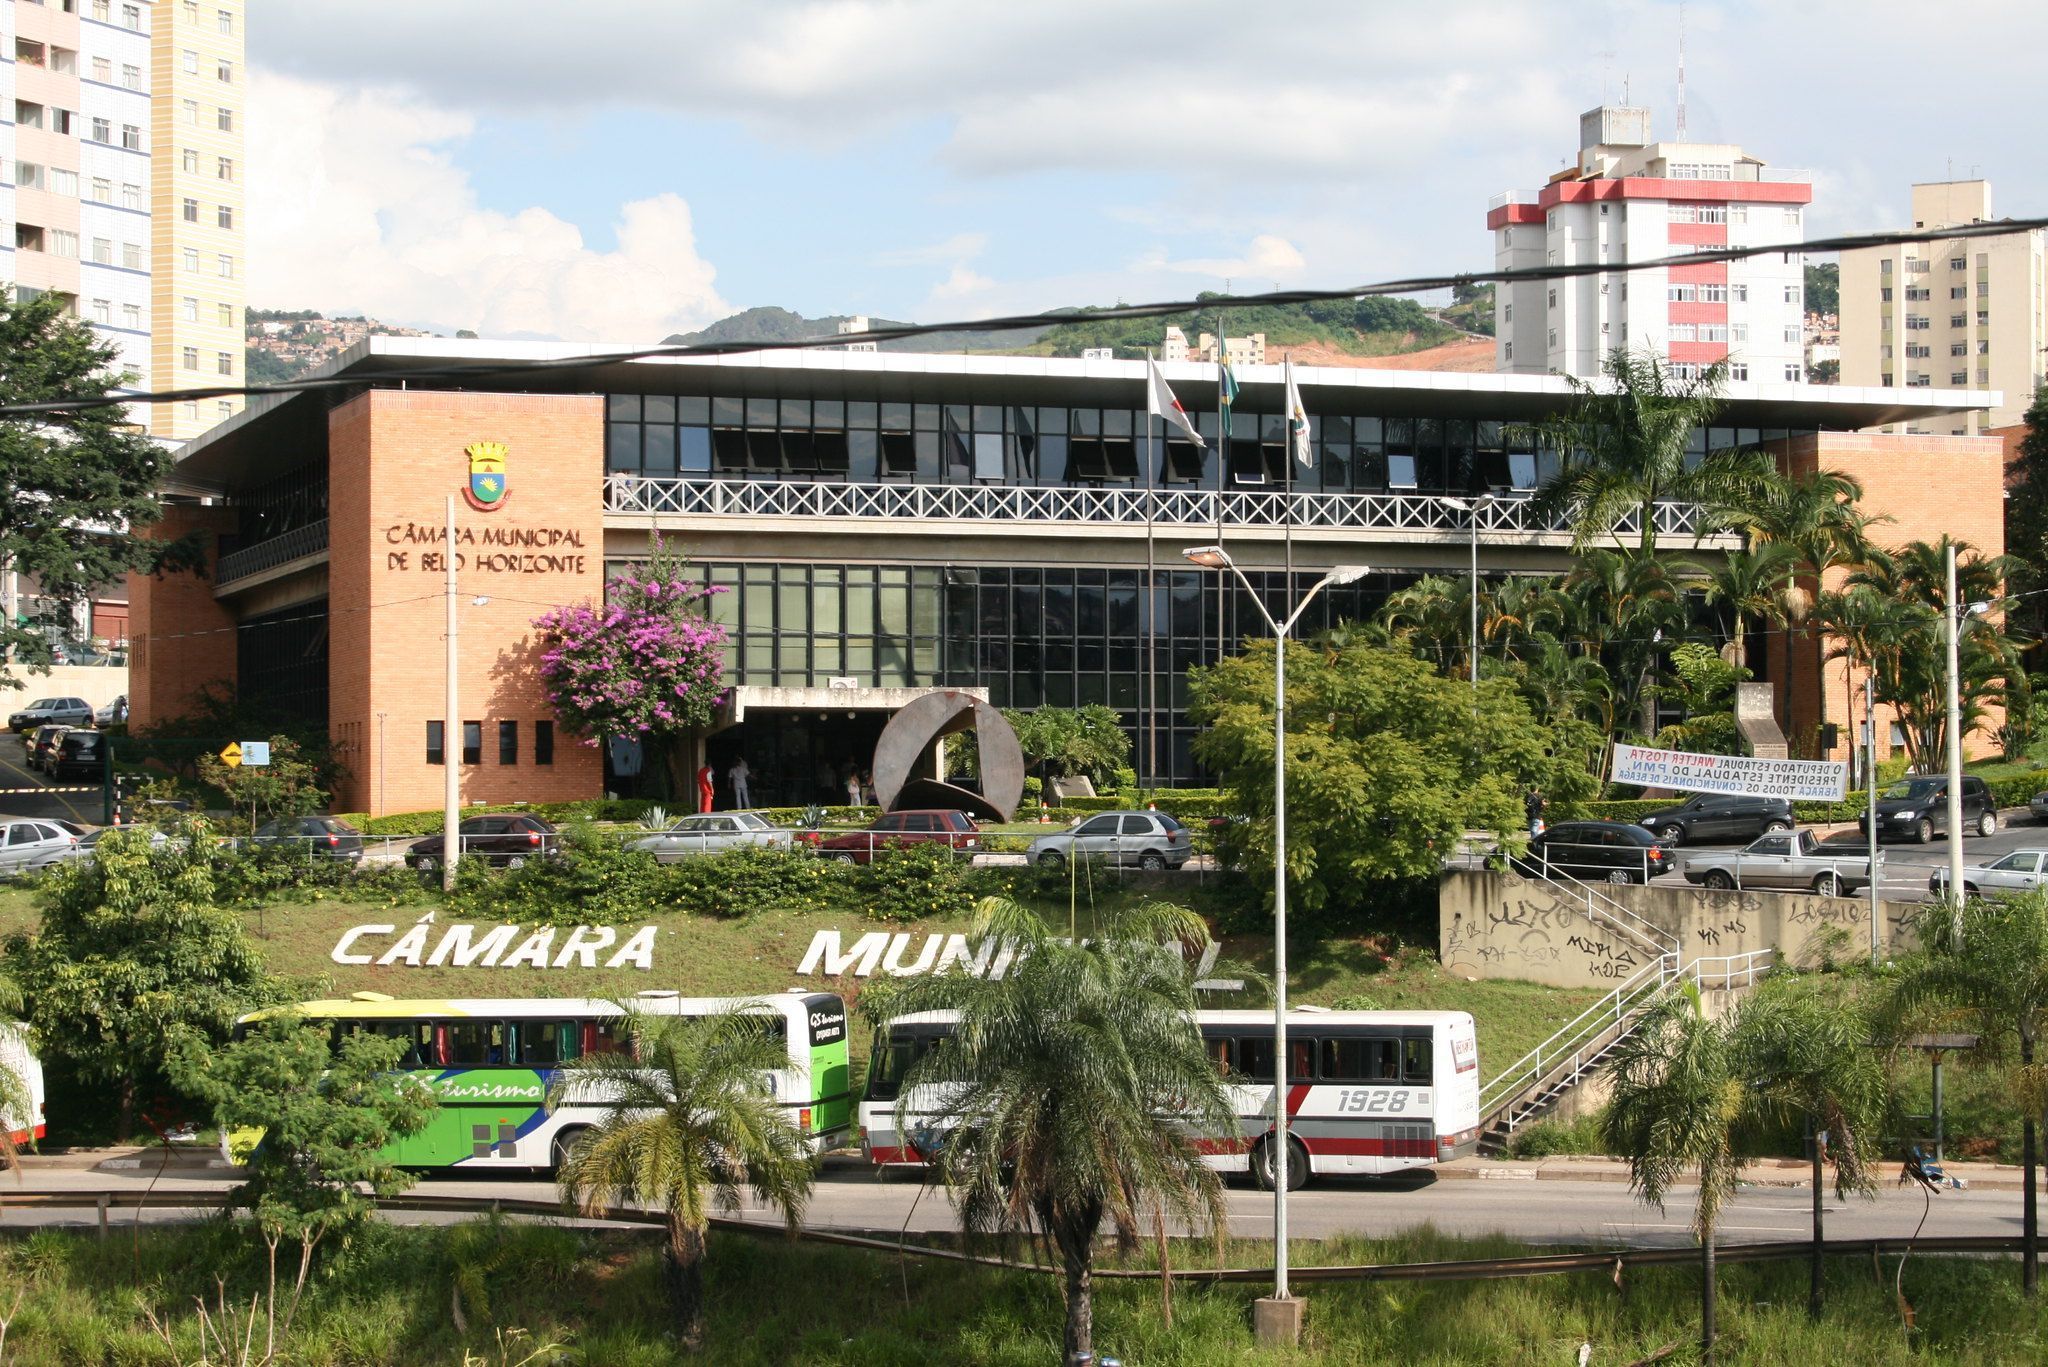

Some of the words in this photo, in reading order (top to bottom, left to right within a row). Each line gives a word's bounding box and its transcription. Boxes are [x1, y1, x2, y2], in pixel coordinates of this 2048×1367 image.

[386, 522, 475, 545] CÂMARA
[483, 527, 585, 548] MUNICIPAL
[388, 552, 408, 571] DE
[422, 552, 466, 572] BELO
[476, 553, 585, 574] HORIZONTE
[331, 911, 658, 969] CÂMARA
[1338, 1090, 1410, 1112] 1928
